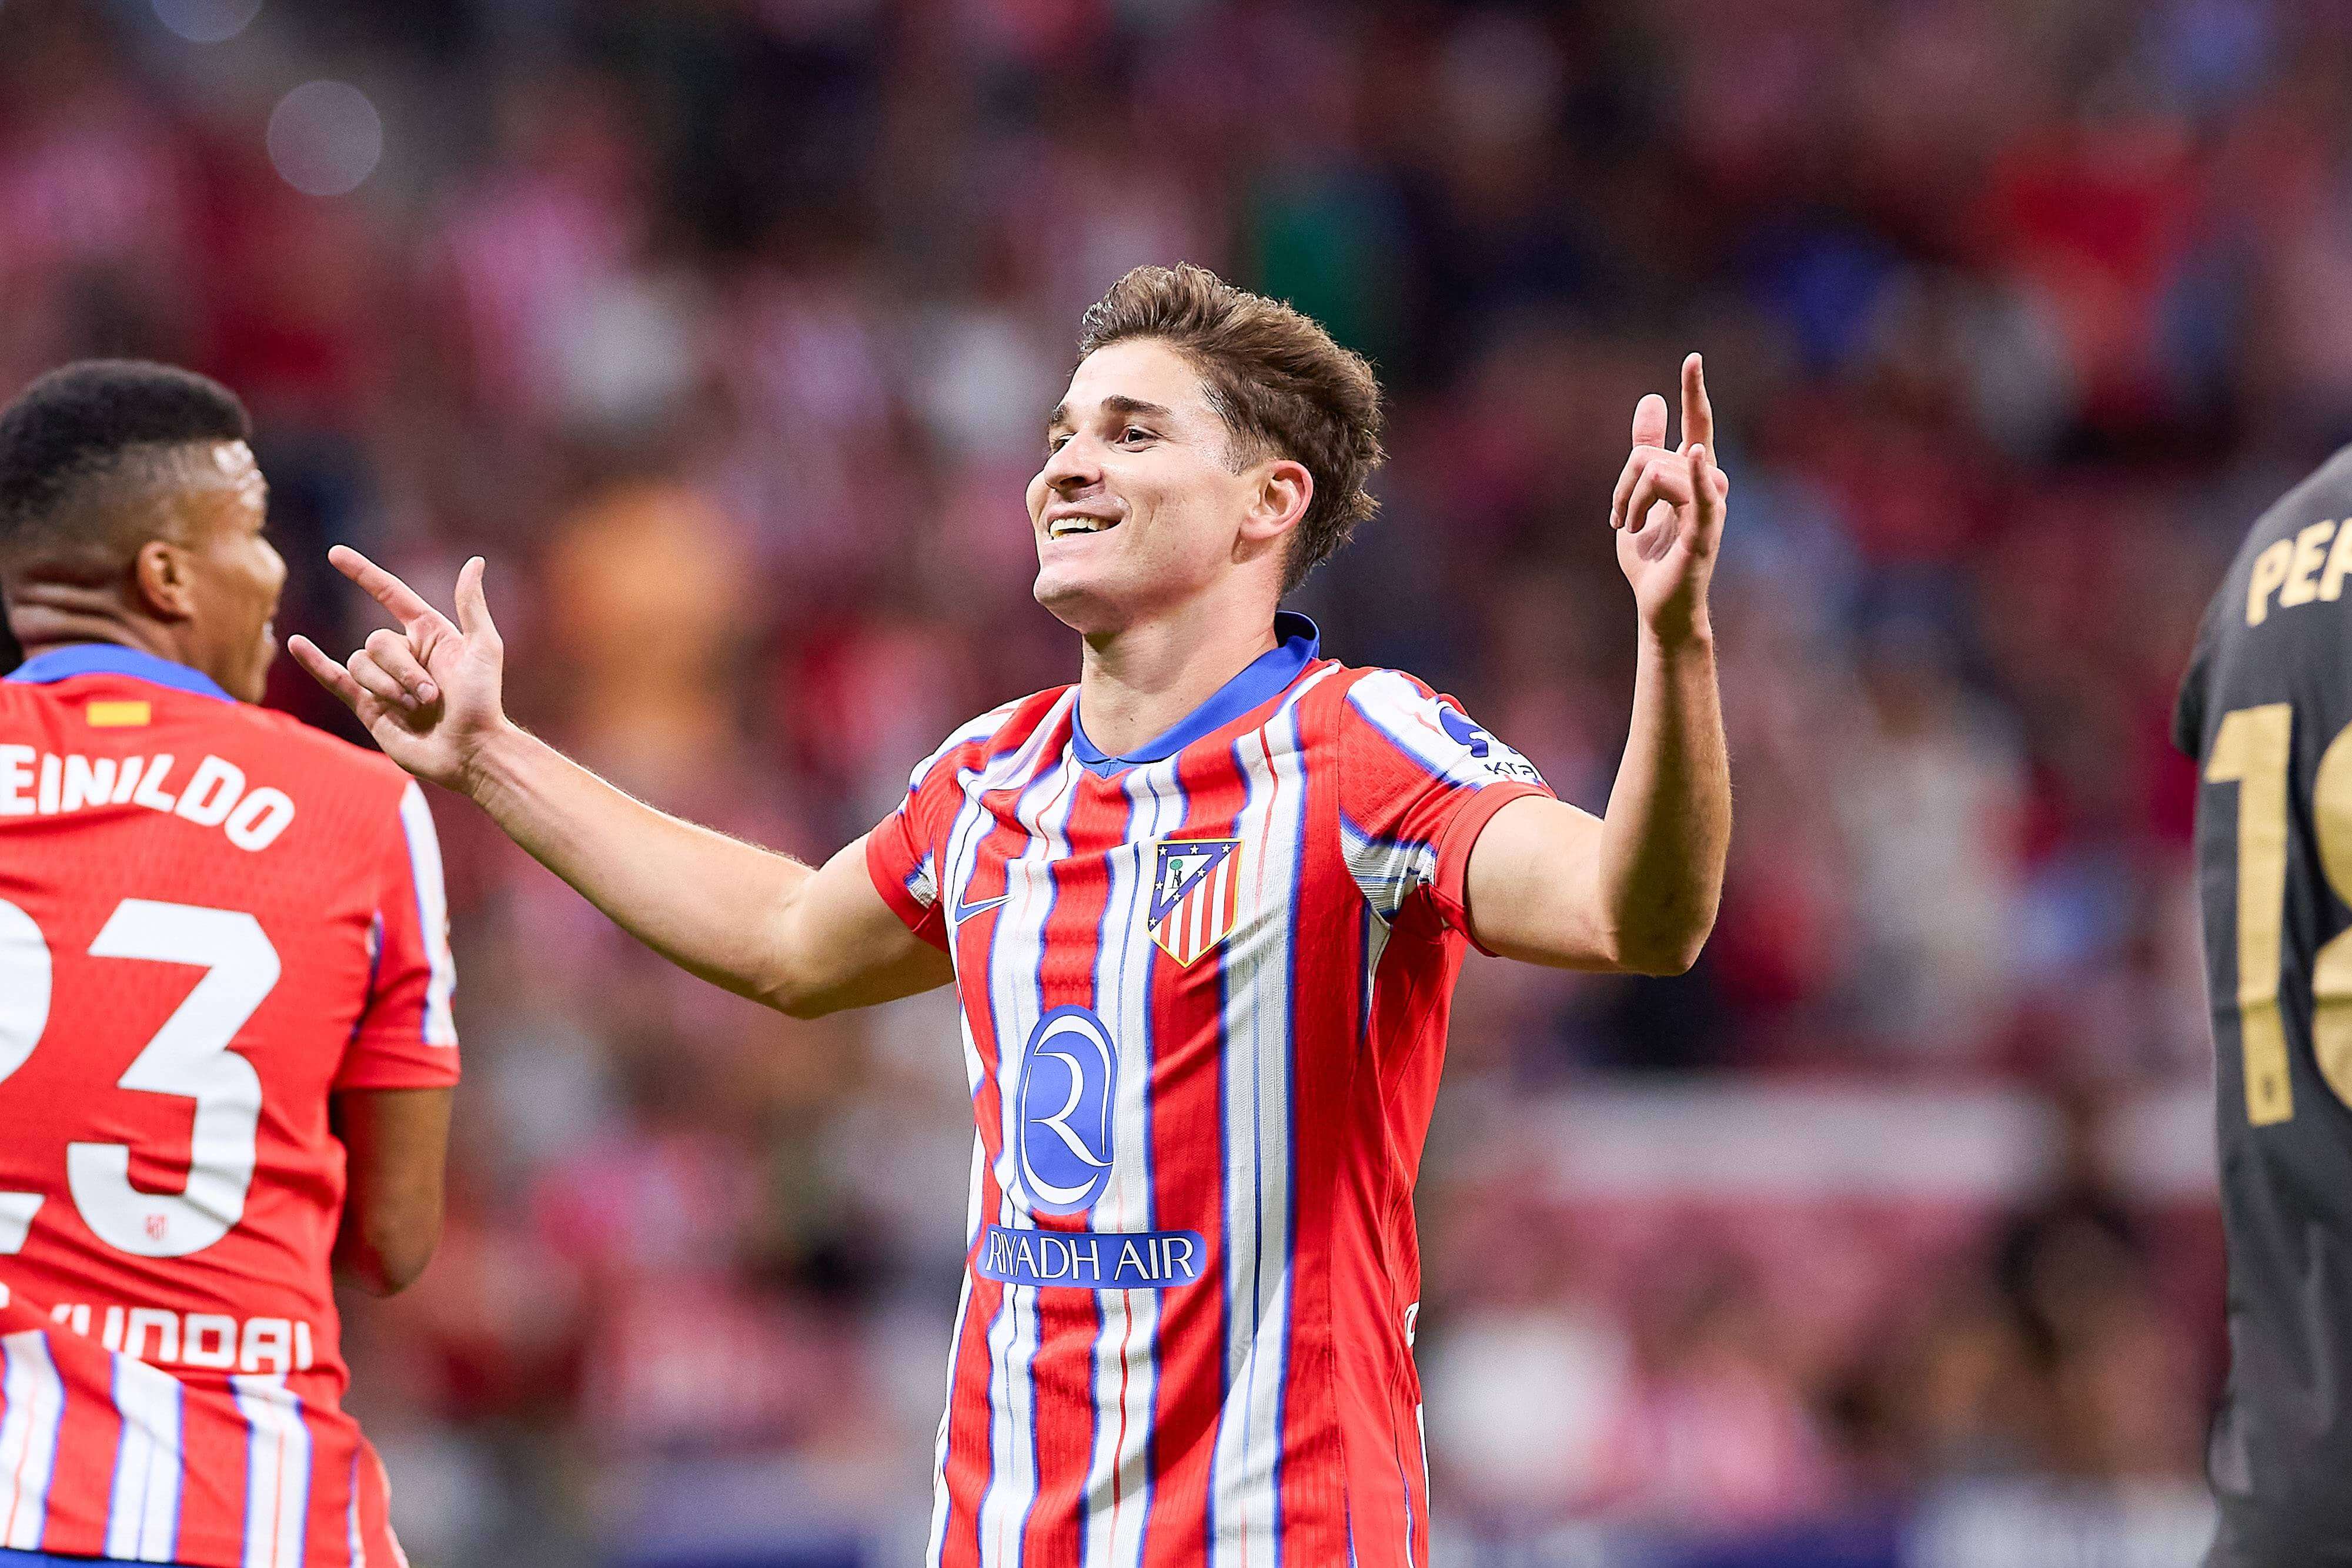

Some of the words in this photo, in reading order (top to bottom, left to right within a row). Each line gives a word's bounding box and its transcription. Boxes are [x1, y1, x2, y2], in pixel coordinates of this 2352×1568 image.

[2206, 703, 2352, 1126] 1
[985, 1231, 1100, 1281] RIYADH
[1114, 1236, 1195, 1281] AIR
